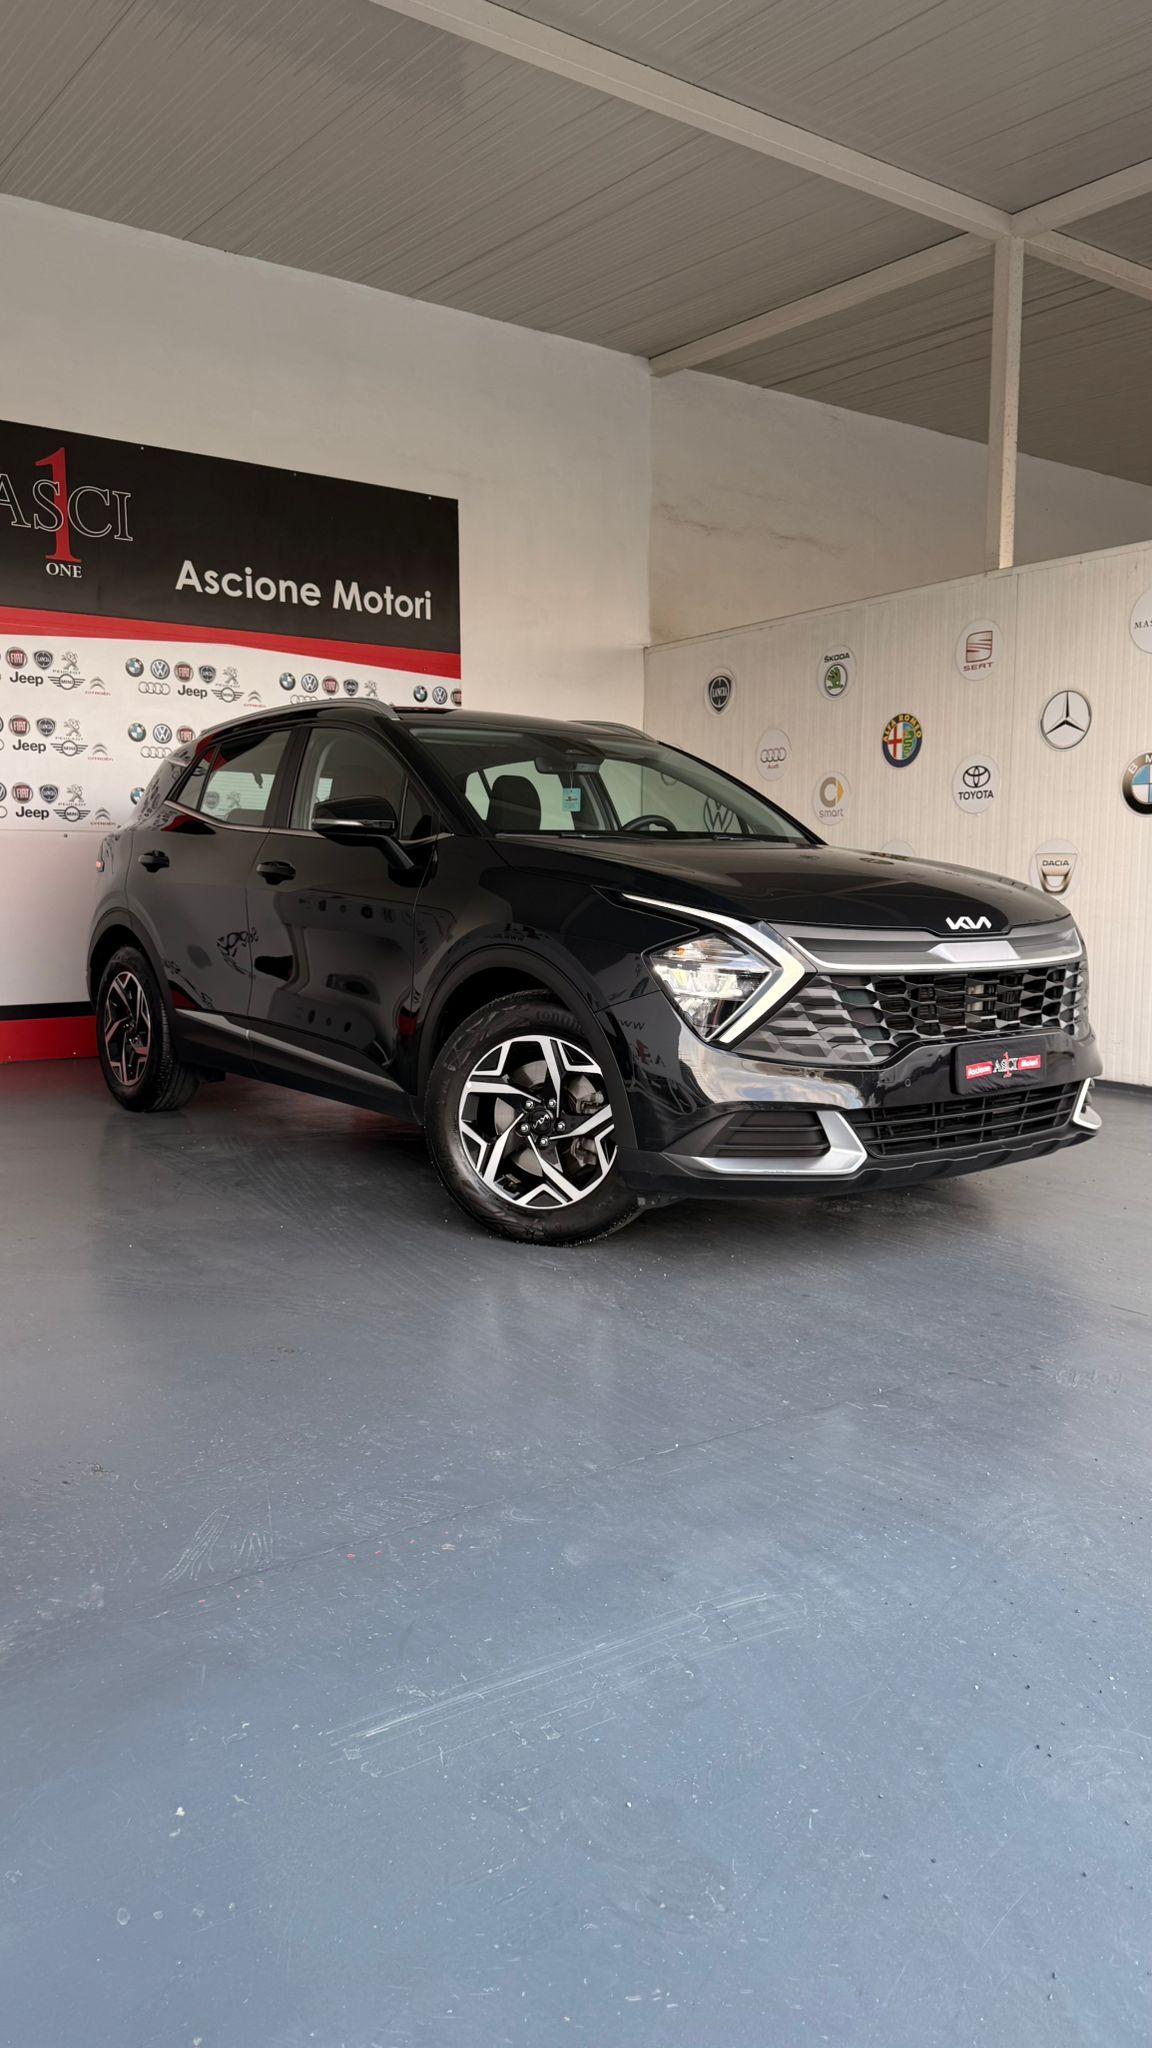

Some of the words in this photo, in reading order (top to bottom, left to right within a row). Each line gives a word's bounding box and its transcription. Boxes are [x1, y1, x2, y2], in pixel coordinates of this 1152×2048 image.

[45, 562, 83, 579] ONE
[175, 560, 322, 607] Ascione
[332, 579, 433, 621] Motori
[963, 661, 993, 672] SEAT
[9, 671, 44, 687] Jeep
[177, 685, 208, 700] Jeep
[12, 739, 47, 754] Jeep
[958, 789, 994, 801] TOYOTA
[15, 806, 50, 820] Jeep
[819, 808, 844, 818] smart
[1042, 859, 1070, 867] DACIA
